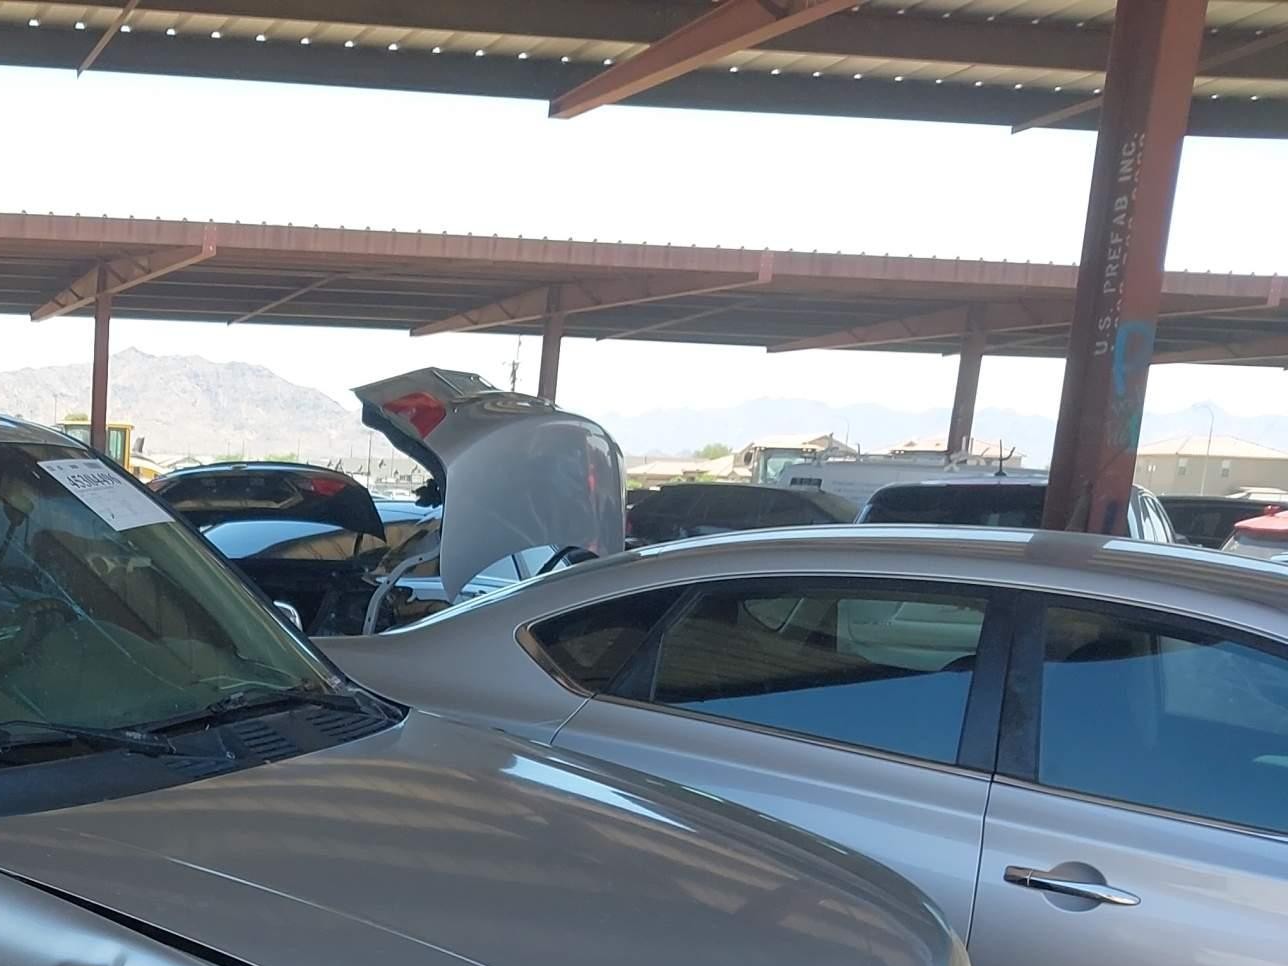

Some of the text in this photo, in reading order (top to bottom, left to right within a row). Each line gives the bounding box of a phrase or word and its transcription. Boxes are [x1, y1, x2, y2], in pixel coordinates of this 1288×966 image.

[1118, 132, 1138, 182] INC.
[1103, 195, 1129, 294] PREFAB
[1094, 308, 1114, 356] U.S.
